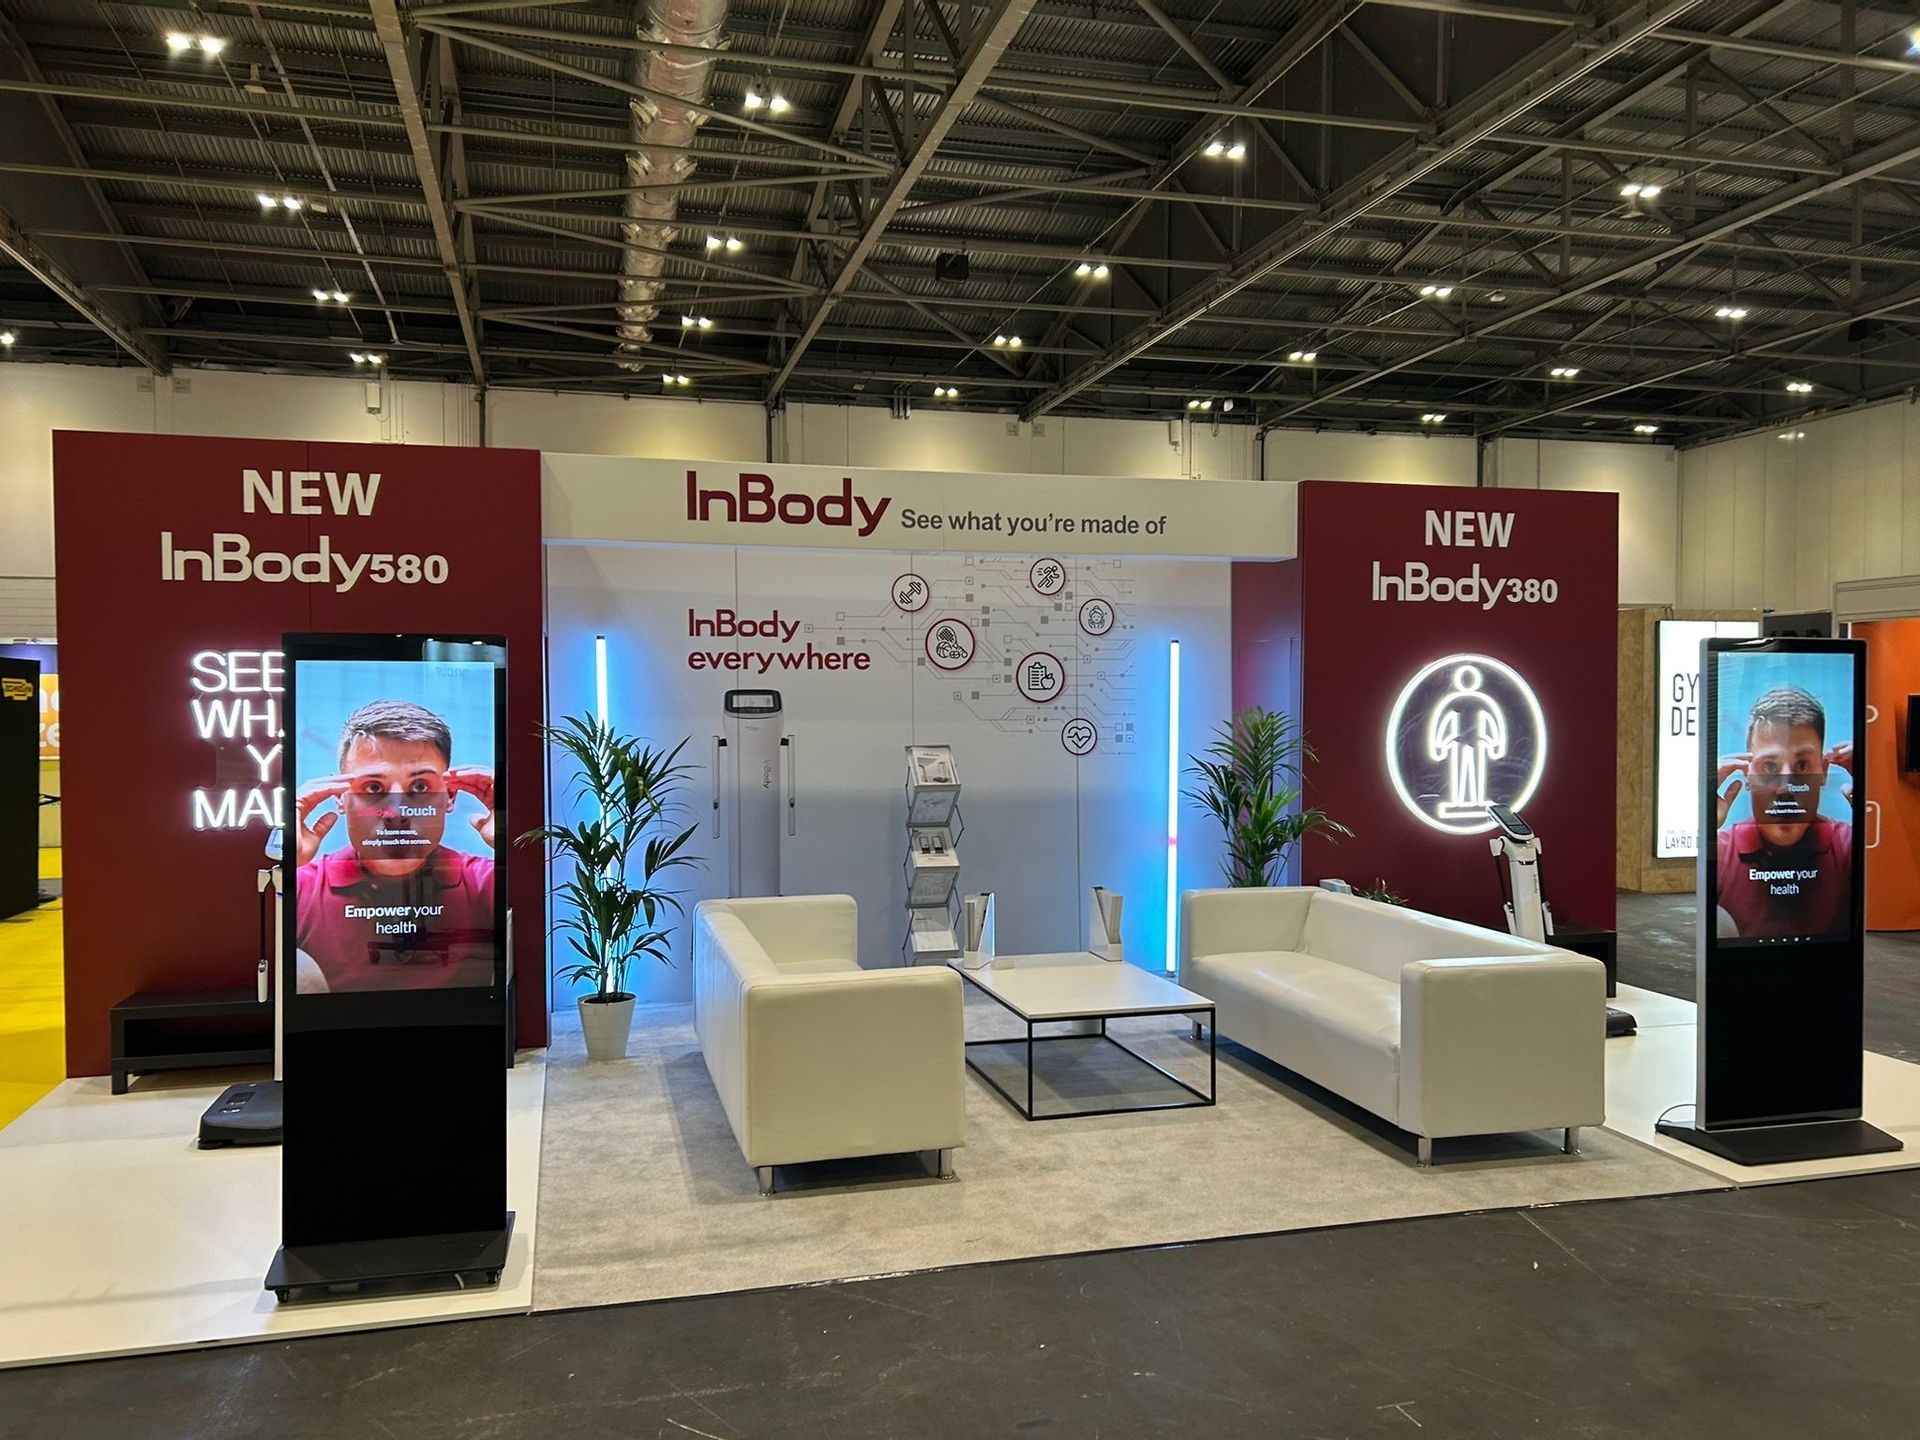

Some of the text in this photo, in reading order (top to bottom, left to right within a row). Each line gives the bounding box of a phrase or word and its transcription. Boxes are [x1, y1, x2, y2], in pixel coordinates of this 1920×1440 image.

[242, 469, 382, 516] NEW
[686, 470, 892, 537] InBody
[901, 508, 1168, 537] See what you’re made of
[1424, 509, 1515, 548] NEW
[160, 531, 450, 593] InBody580
[1371, 561, 1559, 610] InBody380
[688, 608, 801, 639] InBody
[191, 651, 286, 692] SEE
[687, 643, 871, 674] everywhere
[191, 698, 286, 739] WH
[1787, 784, 1810, 792] Touch
[399, 806, 436, 816] Touch
[362, 839, 382, 847] simply
[1749, 869, 1818, 881] Empower your
[1770, 884, 1799, 895] health
[345, 905, 444, 919] Empower your
[376, 922, 417, 934] health
